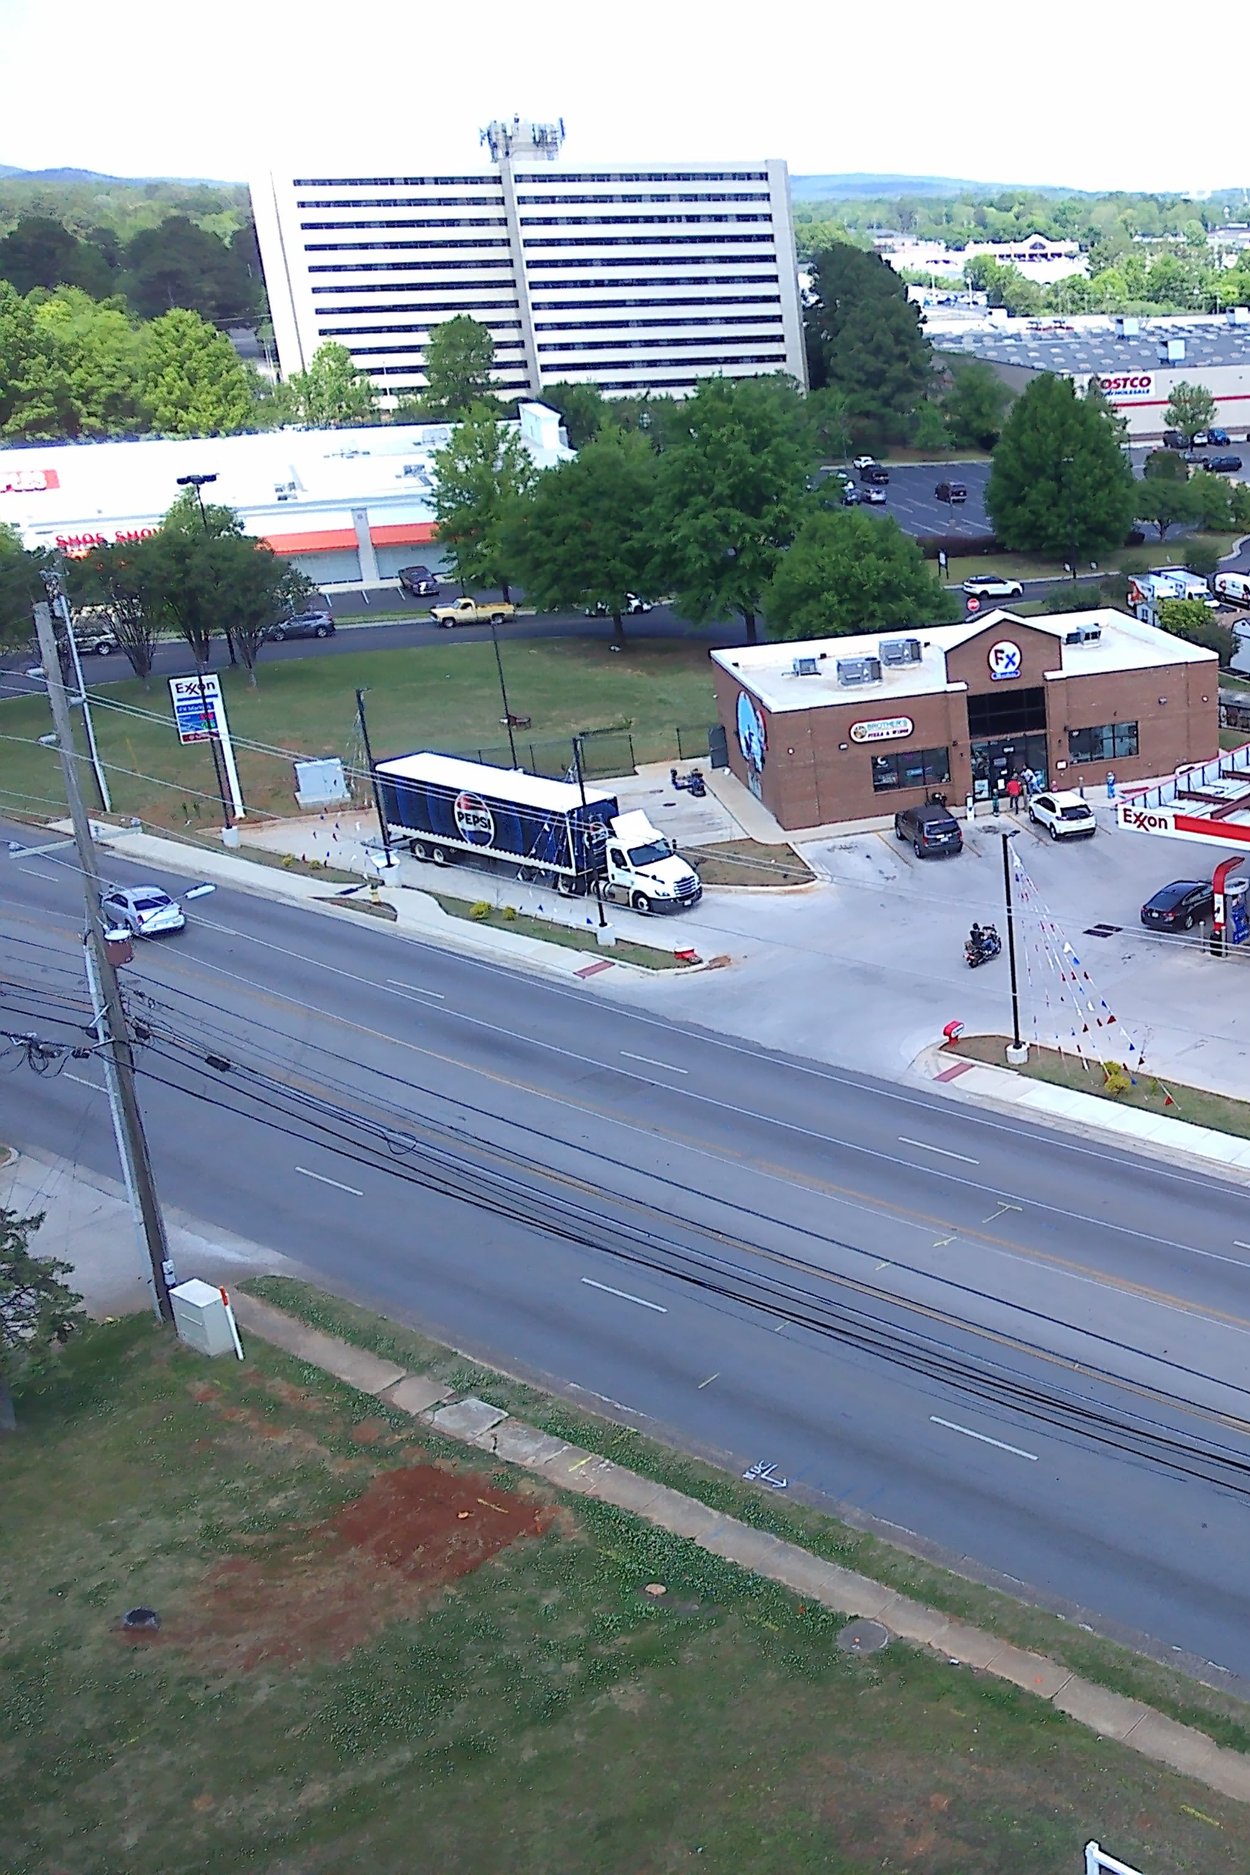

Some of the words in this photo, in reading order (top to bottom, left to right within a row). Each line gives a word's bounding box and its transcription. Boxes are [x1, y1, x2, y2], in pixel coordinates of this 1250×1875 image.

[1091, 376, 1152, 390] OSTCO
[175, 681, 216, 695] Exxon
[457, 811, 492, 830] PEPSI
[1123, 808, 1168, 832] Exxon
